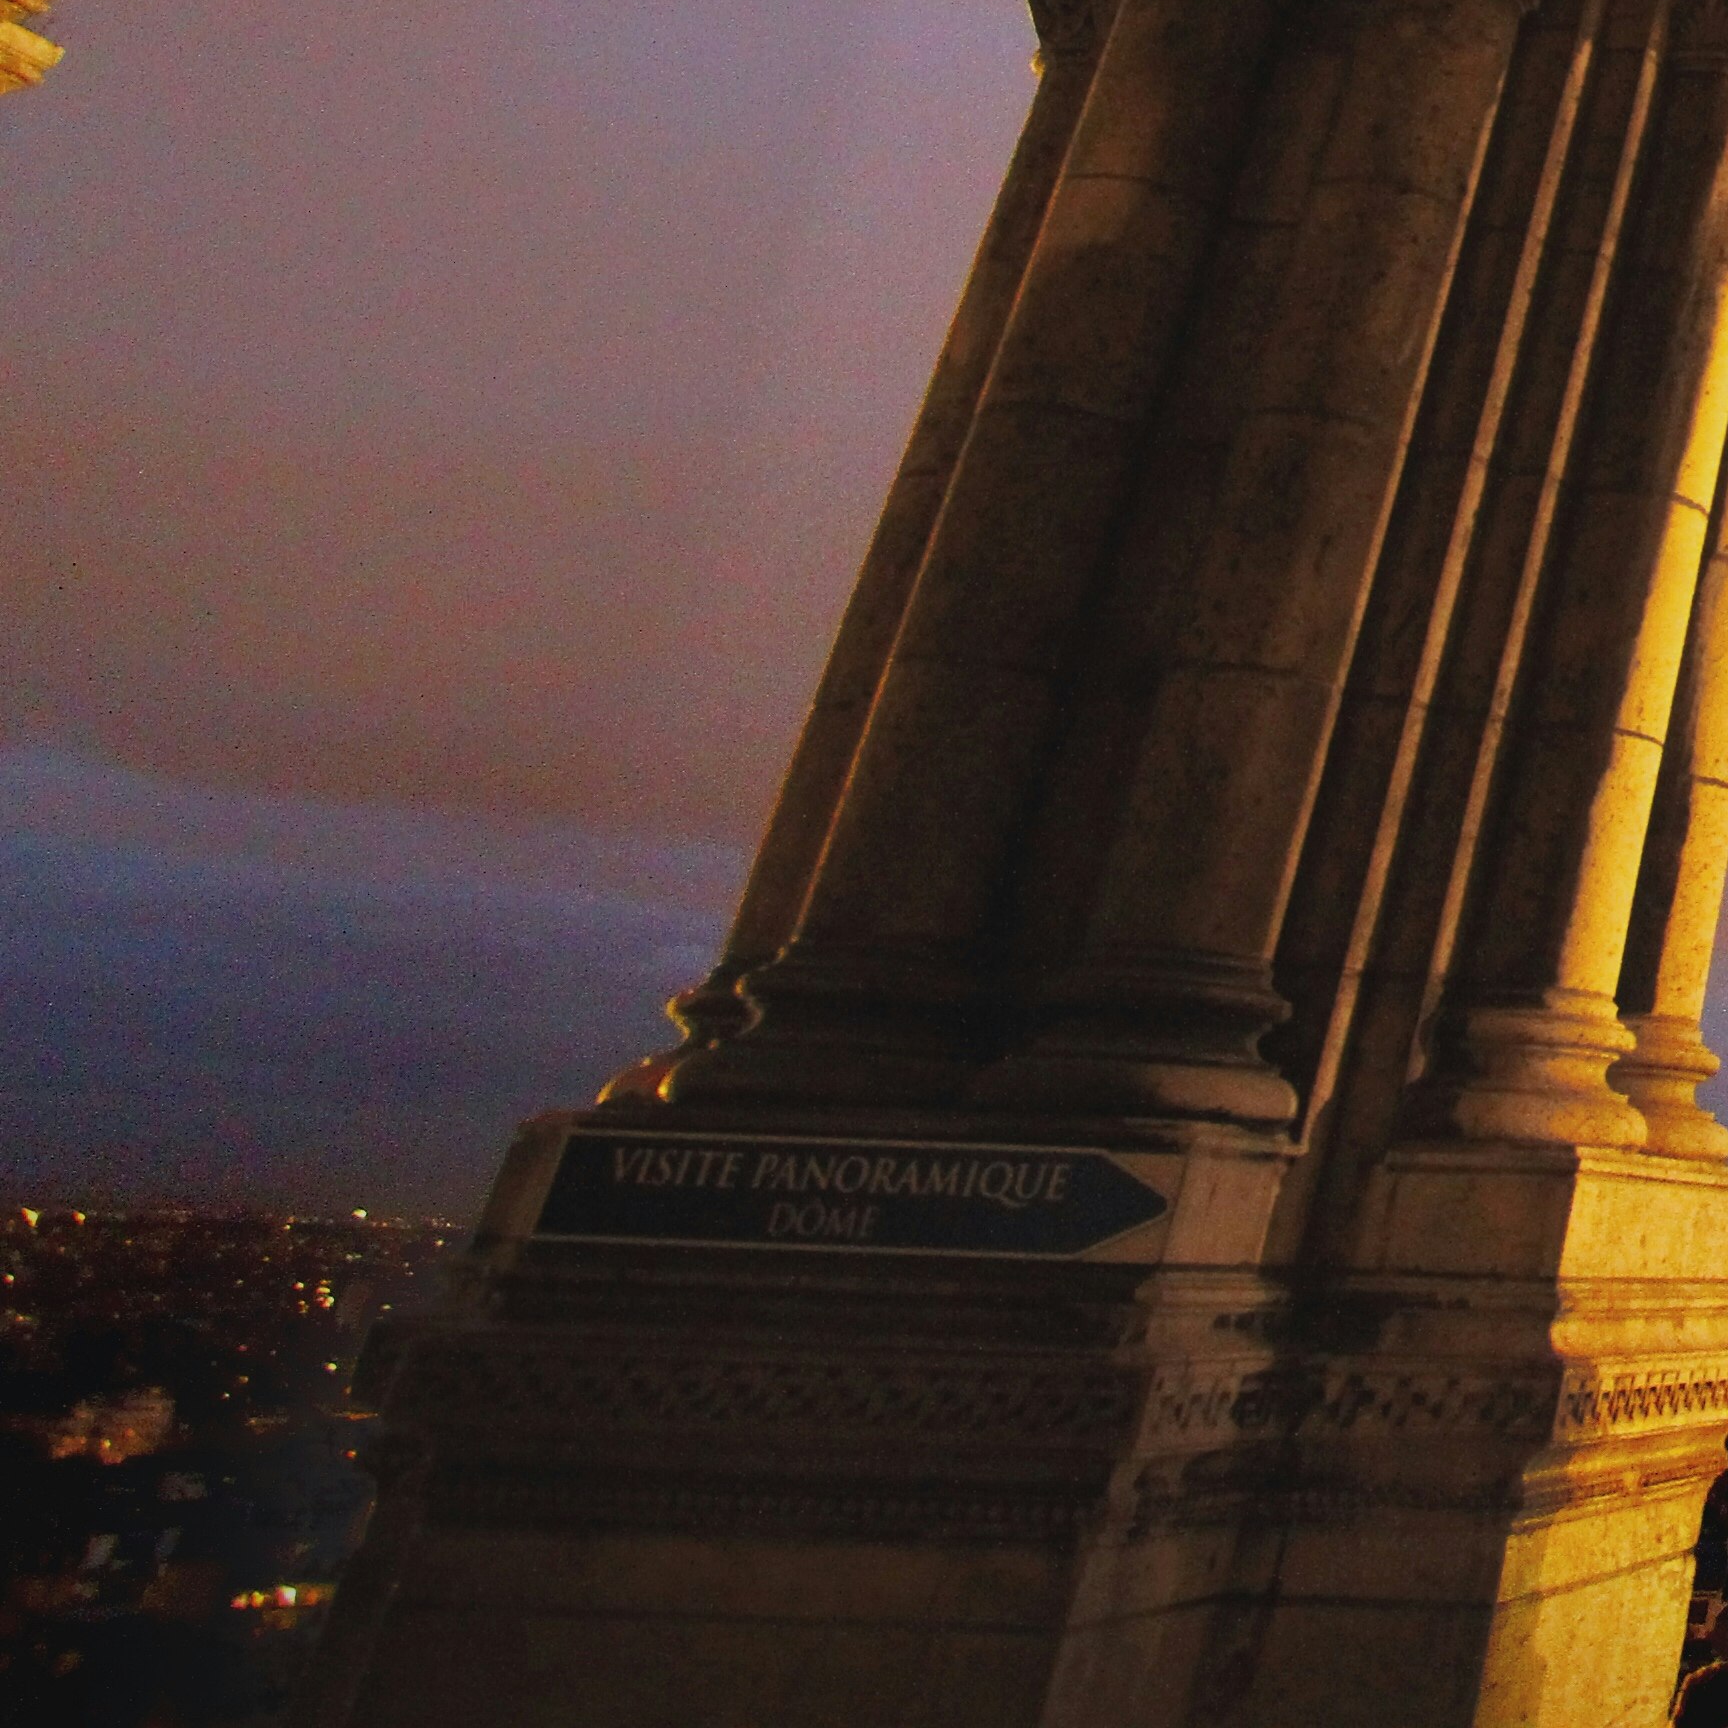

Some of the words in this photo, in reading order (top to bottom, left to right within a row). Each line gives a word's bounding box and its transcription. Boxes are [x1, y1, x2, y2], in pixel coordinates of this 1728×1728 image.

[611, 1147, 744, 1189] VISITE
[749, 1152, 1069, 1208] PANORAMIQUE
[766, 1202, 880, 1240] DÔME
